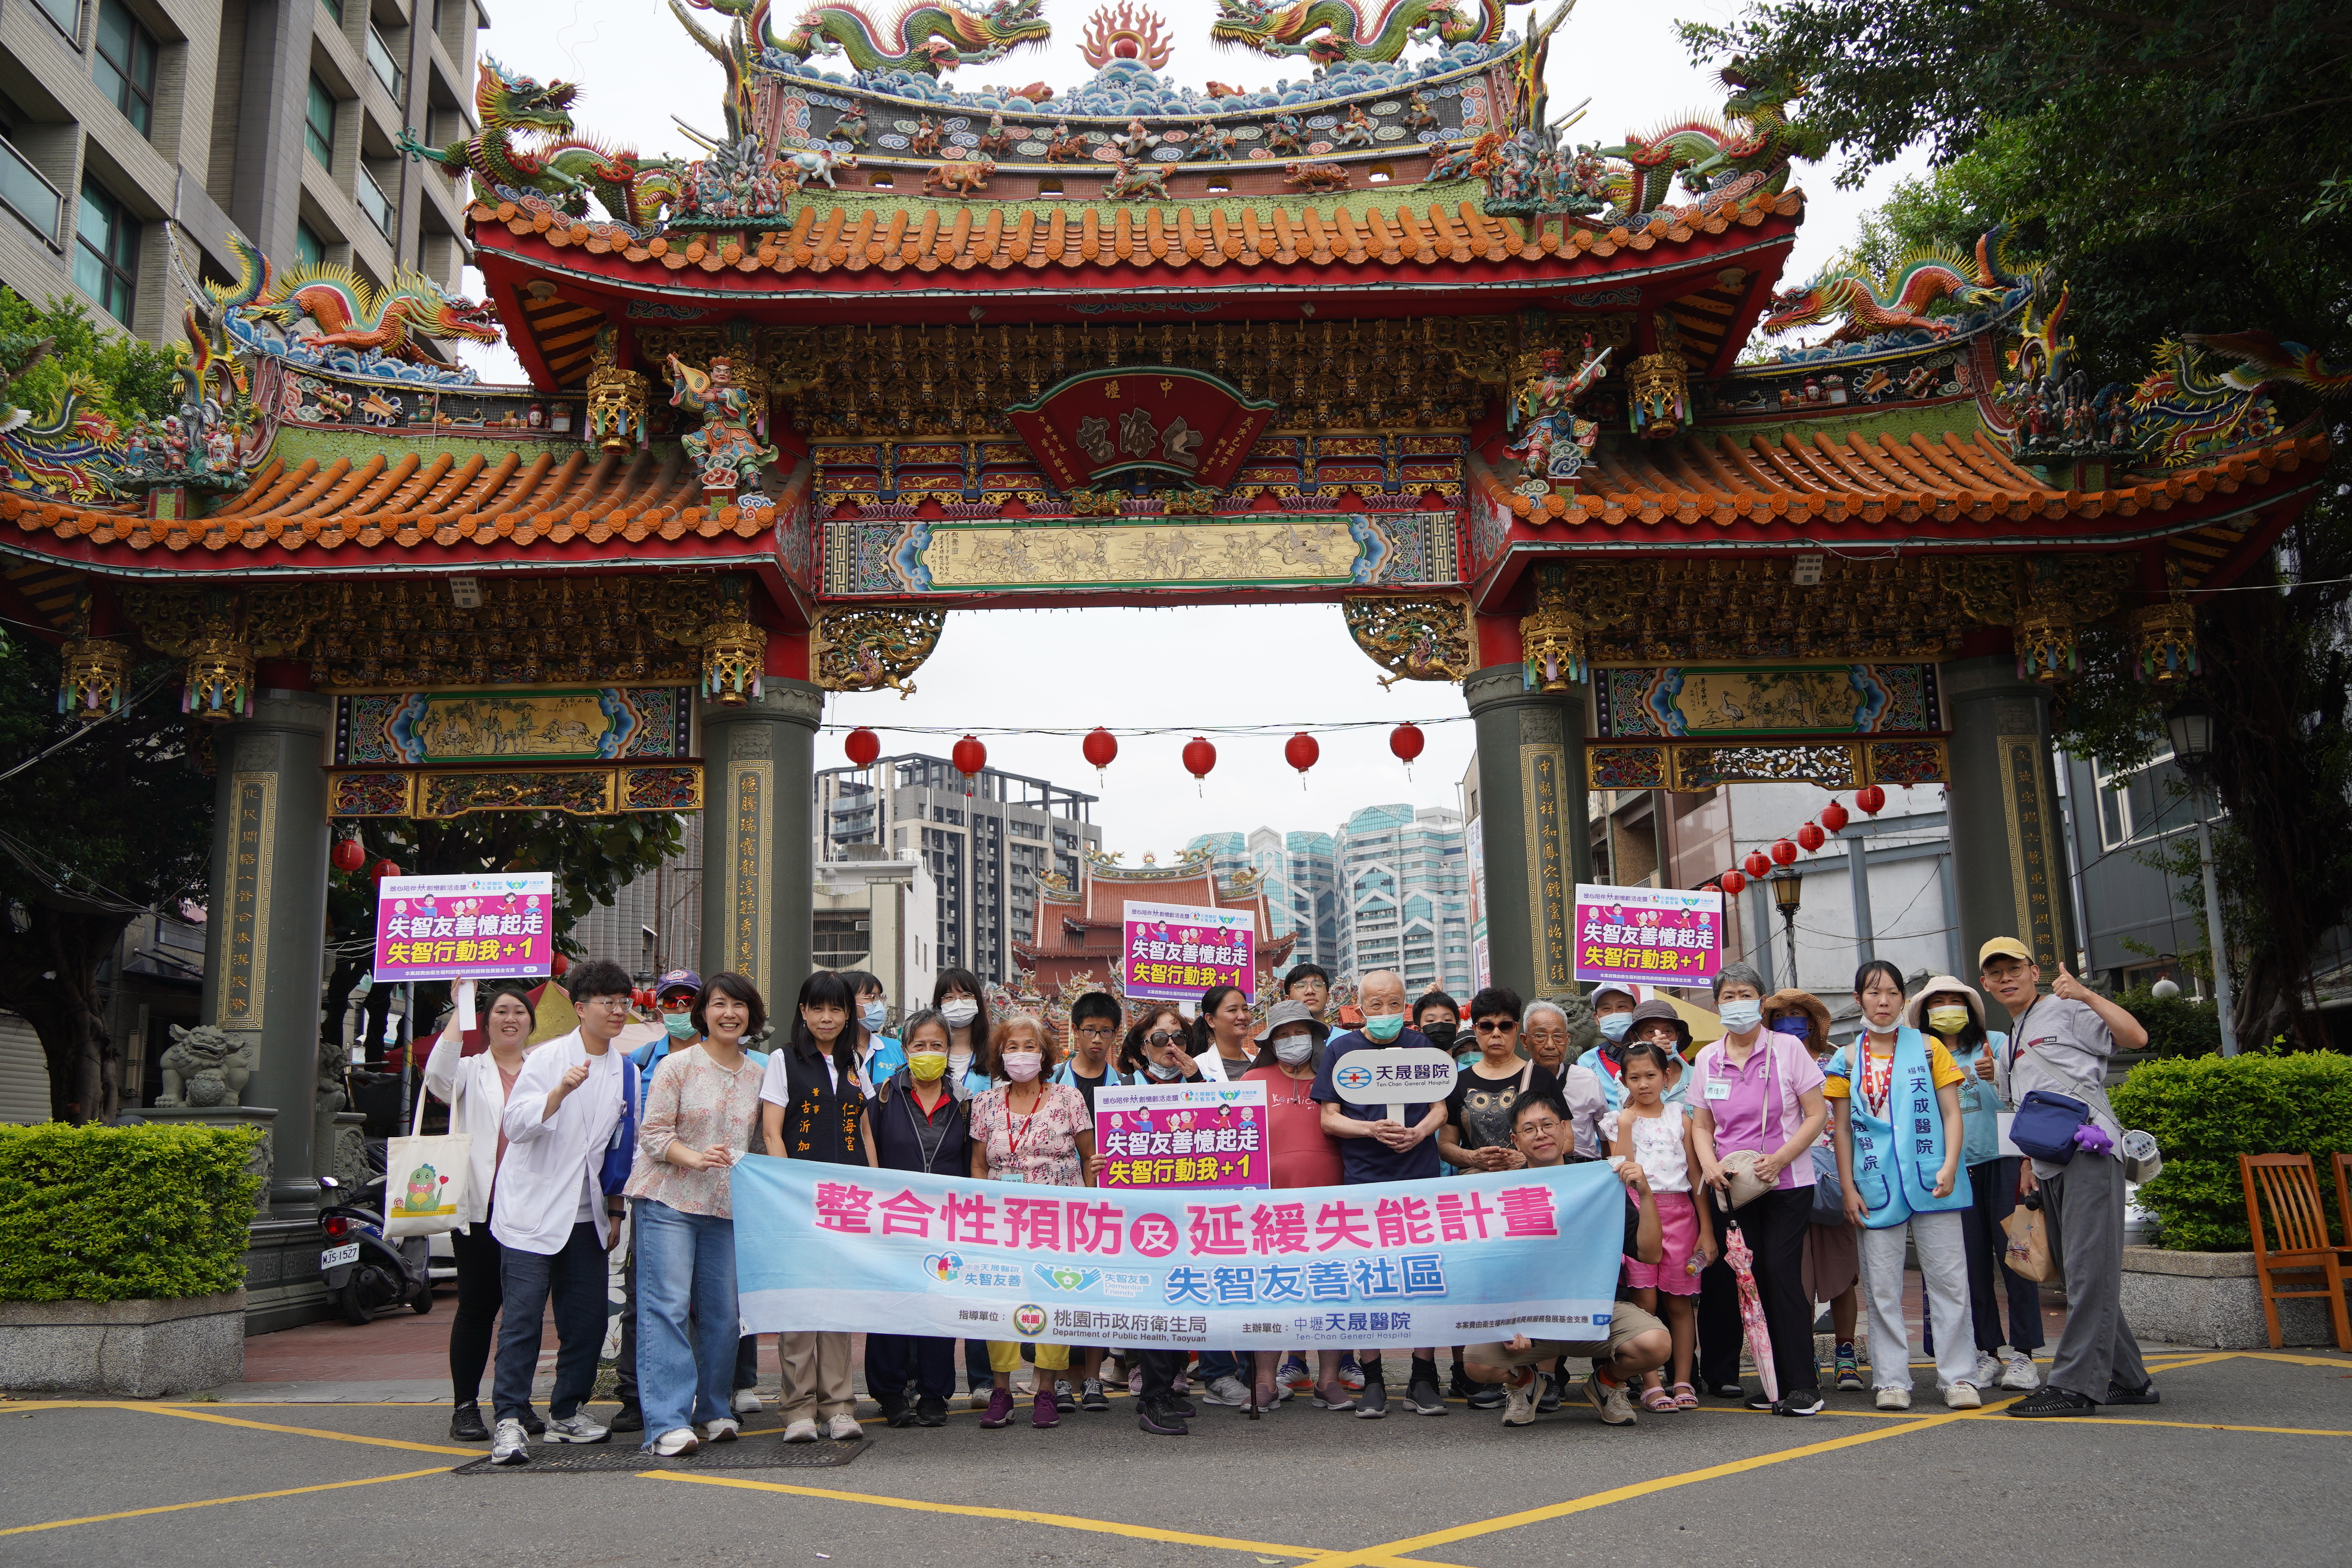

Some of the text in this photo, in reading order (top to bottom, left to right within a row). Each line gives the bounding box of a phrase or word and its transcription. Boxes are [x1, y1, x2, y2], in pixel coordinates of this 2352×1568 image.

[385, 914, 544, 939] 失智友善憶起走
[1583, 923, 1714, 950] 失智友善憶起走
[386, 937, 532, 964] 失智行動我+1
[1131, 939, 1248, 967] 失智友善憶起走
[1584, 945, 1705, 970] 失智行動我+1
[1132, 962, 1241, 987] 失智行動我+1
[1376, 1064, 1450, 1080] 天晟醫院
[811, 1087, 820, 1114] 董事
[797, 1100, 811, 1152] 古沂加
[842, 1102, 857, 1151] 仁海宮
[1910, 1077, 1934, 1155] 天成醫院
[1105, 1127, 1259, 1157] 失智友善憶起走
[1108, 1154, 1250, 1186] 失智行動我+1
[815, 1183, 1558, 1256] 整合性預防及延緩失能計畫
[964, 1273, 1021, 1287] 失智友善
[966, 1263, 1020, 1273] 中壢天晟醫院
[1105, 1273, 1150, 1285] 失智友善
[1166, 1254, 1446, 1300] 失智友善社區
[1105, 1282, 1141, 1291] Dementia
[1021, 1314, 1040, 1324] 桃園
[1054, 1309, 1206, 1333] 桃園市政府衛生局
[1294, 1312, 1411, 1331] 中壢天晟醫院
[1053, 1328, 1100, 1337] Department
[1140, 1333, 1169, 1342] Health,
[1172, 1334, 1206, 1343] Taoyuan
